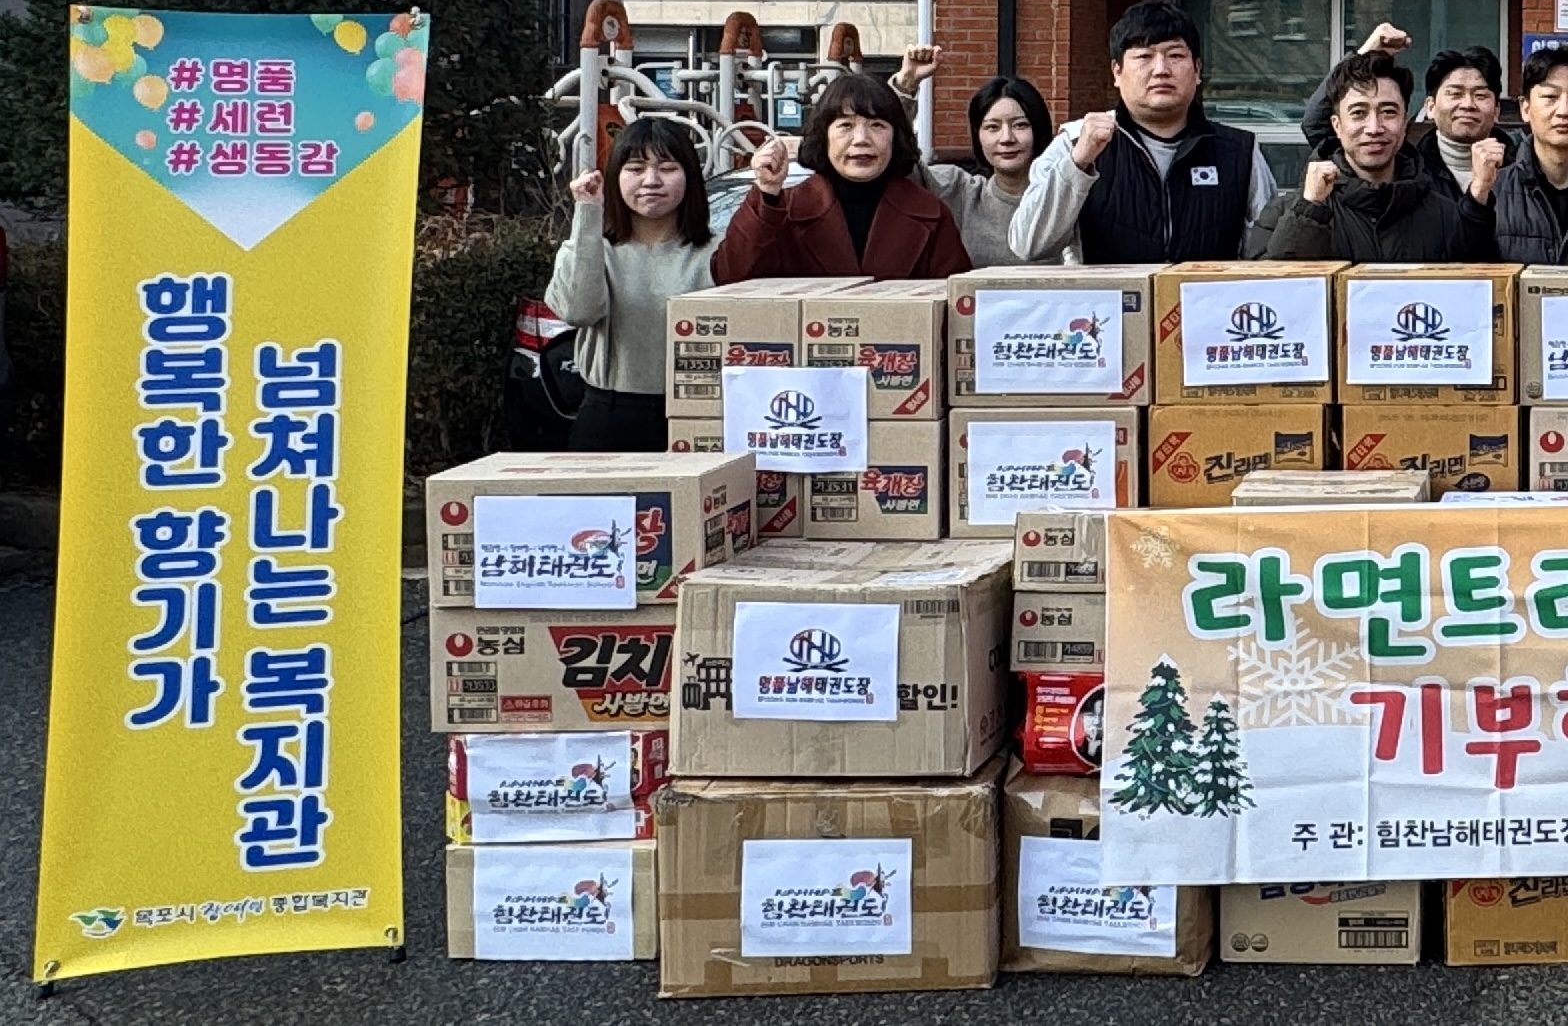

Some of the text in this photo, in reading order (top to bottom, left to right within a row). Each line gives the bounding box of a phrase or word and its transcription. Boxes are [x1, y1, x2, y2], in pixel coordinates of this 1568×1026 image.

[171, 60, 294, 93] #명품
[170, 101, 293, 134] #세련
[167, 142, 337, 175] #생동감
[992, 341, 1098, 361] 힘찬태권도
[1206, 343, 1305, 362] 명품남해태권도장
[1370, 344, 1469, 362] 명품남해태권도장
[1203, 451, 1272, 485] 진라면
[860, 470, 925, 497] 육개장
[986, 473, 1094, 492] 힘찬태권도
[129, 276, 229, 727] 행복한 향기가
[480, 554, 616, 579] 남해태권도
[238, 342, 339, 869] 넘쳐나는 복지관
[475, 636, 526, 656] 농심
[561, 635, 672, 689] 김치
[758, 676, 872, 698] 명품남해태권도장
[898, 683, 958, 711] 할인!
[488, 790, 603, 808] 힘찬태권도
[1291, 822, 1318, 851] 주
[1328, 821, 1364, 850] 관:
[493, 904, 606, 925] 힘찬태권도
[761, 897, 883, 919] 힘찬태권도
[1037, 895, 1150, 920] 힘찬태권도
